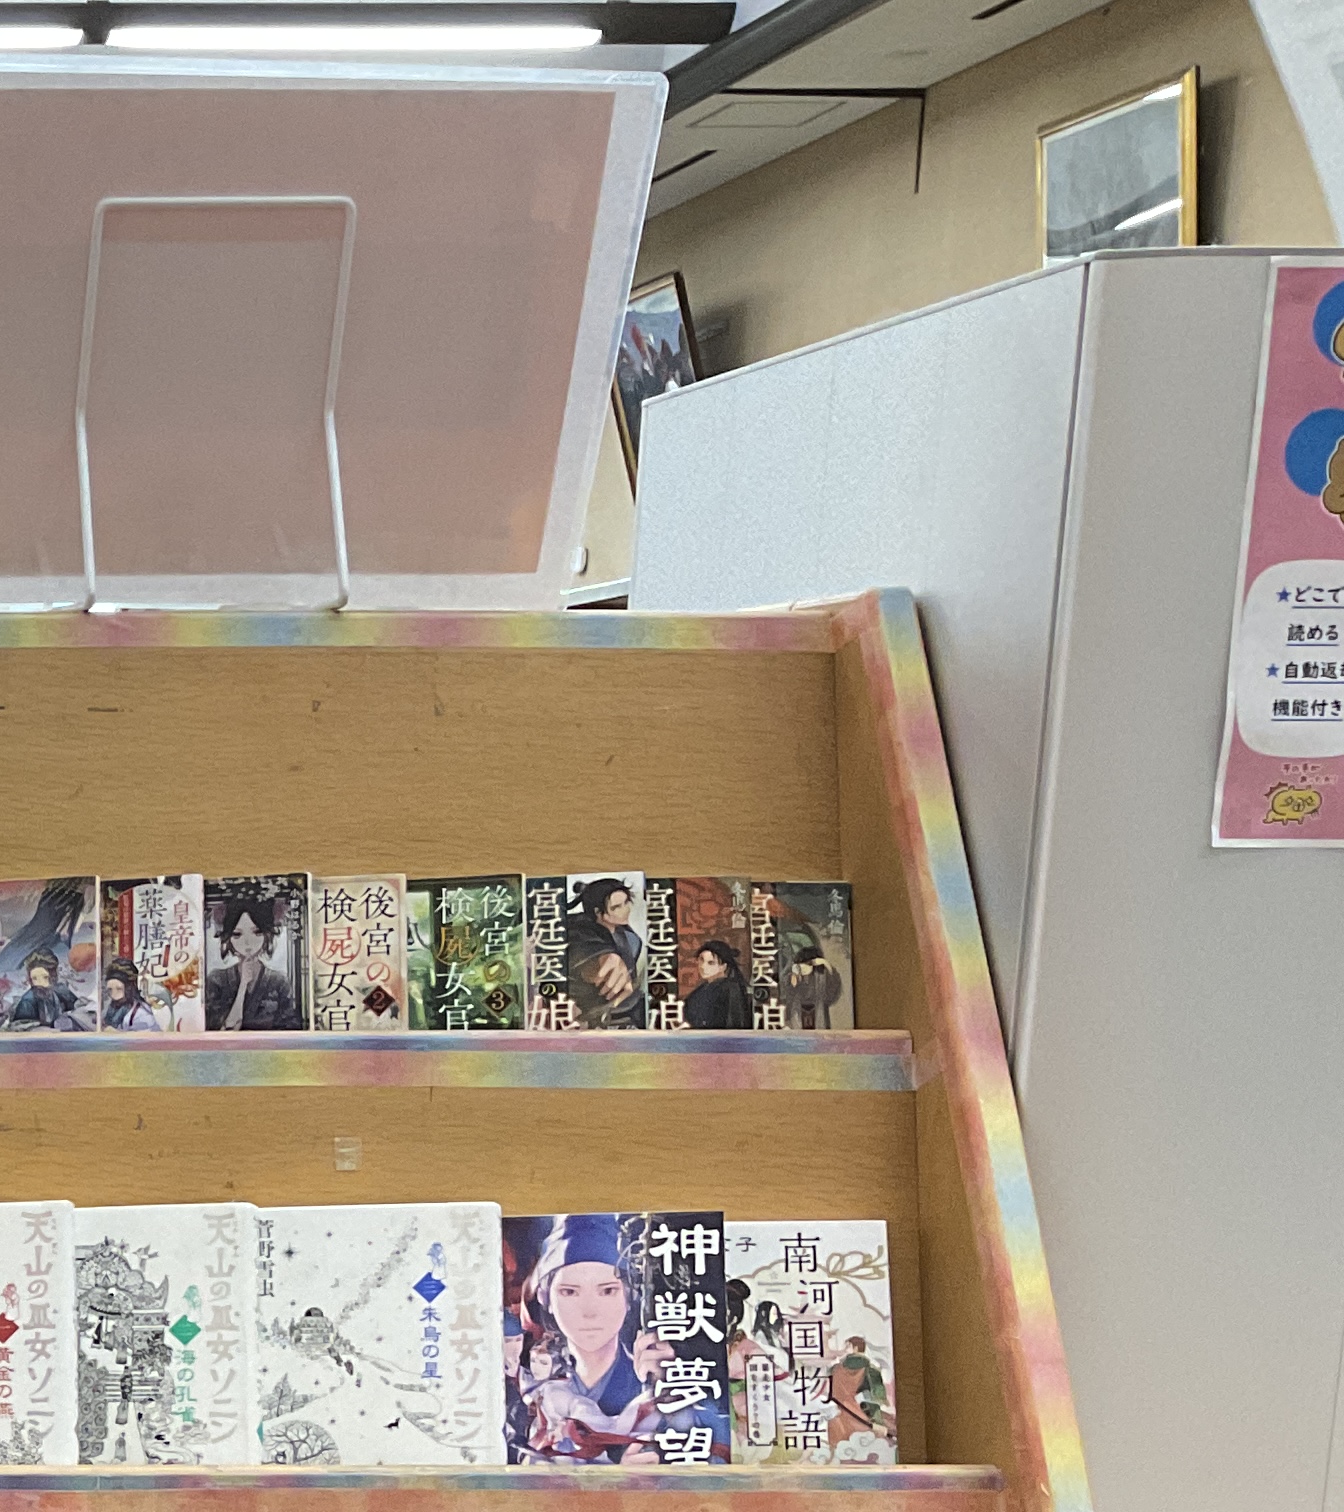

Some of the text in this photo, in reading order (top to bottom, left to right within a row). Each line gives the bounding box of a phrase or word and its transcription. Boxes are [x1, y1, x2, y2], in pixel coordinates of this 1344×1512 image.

[1287, 623, 1339, 641] 読める
[1272, 699, 1342, 717] 機能付き
[136, 890, 168, 979] 薬膳妃
[170, 901, 194, 963] 皇帝の
[317, 888, 360, 1031] 検屍女官
[358, 886, 397, 982] 後宮の
[435, 887, 477, 1031] 検屍女官
[480, 885, 515, 982] 後宮の
[527, 882, 580, 1031] 宮廷医の娘
[373, 992, 385, 1007] 2
[492, 993, 505, 1009] 3
[21, 1211, 56, 1440] 天山の巫女ソニン
[420, 1307, 442, 1378] 朱鳥の星
[647, 1223, 724, 1465] 神獣夢望
[778, 1232, 839, 1450] 南河国物語
[172, 1350, 196, 1423] 海の孔雀
